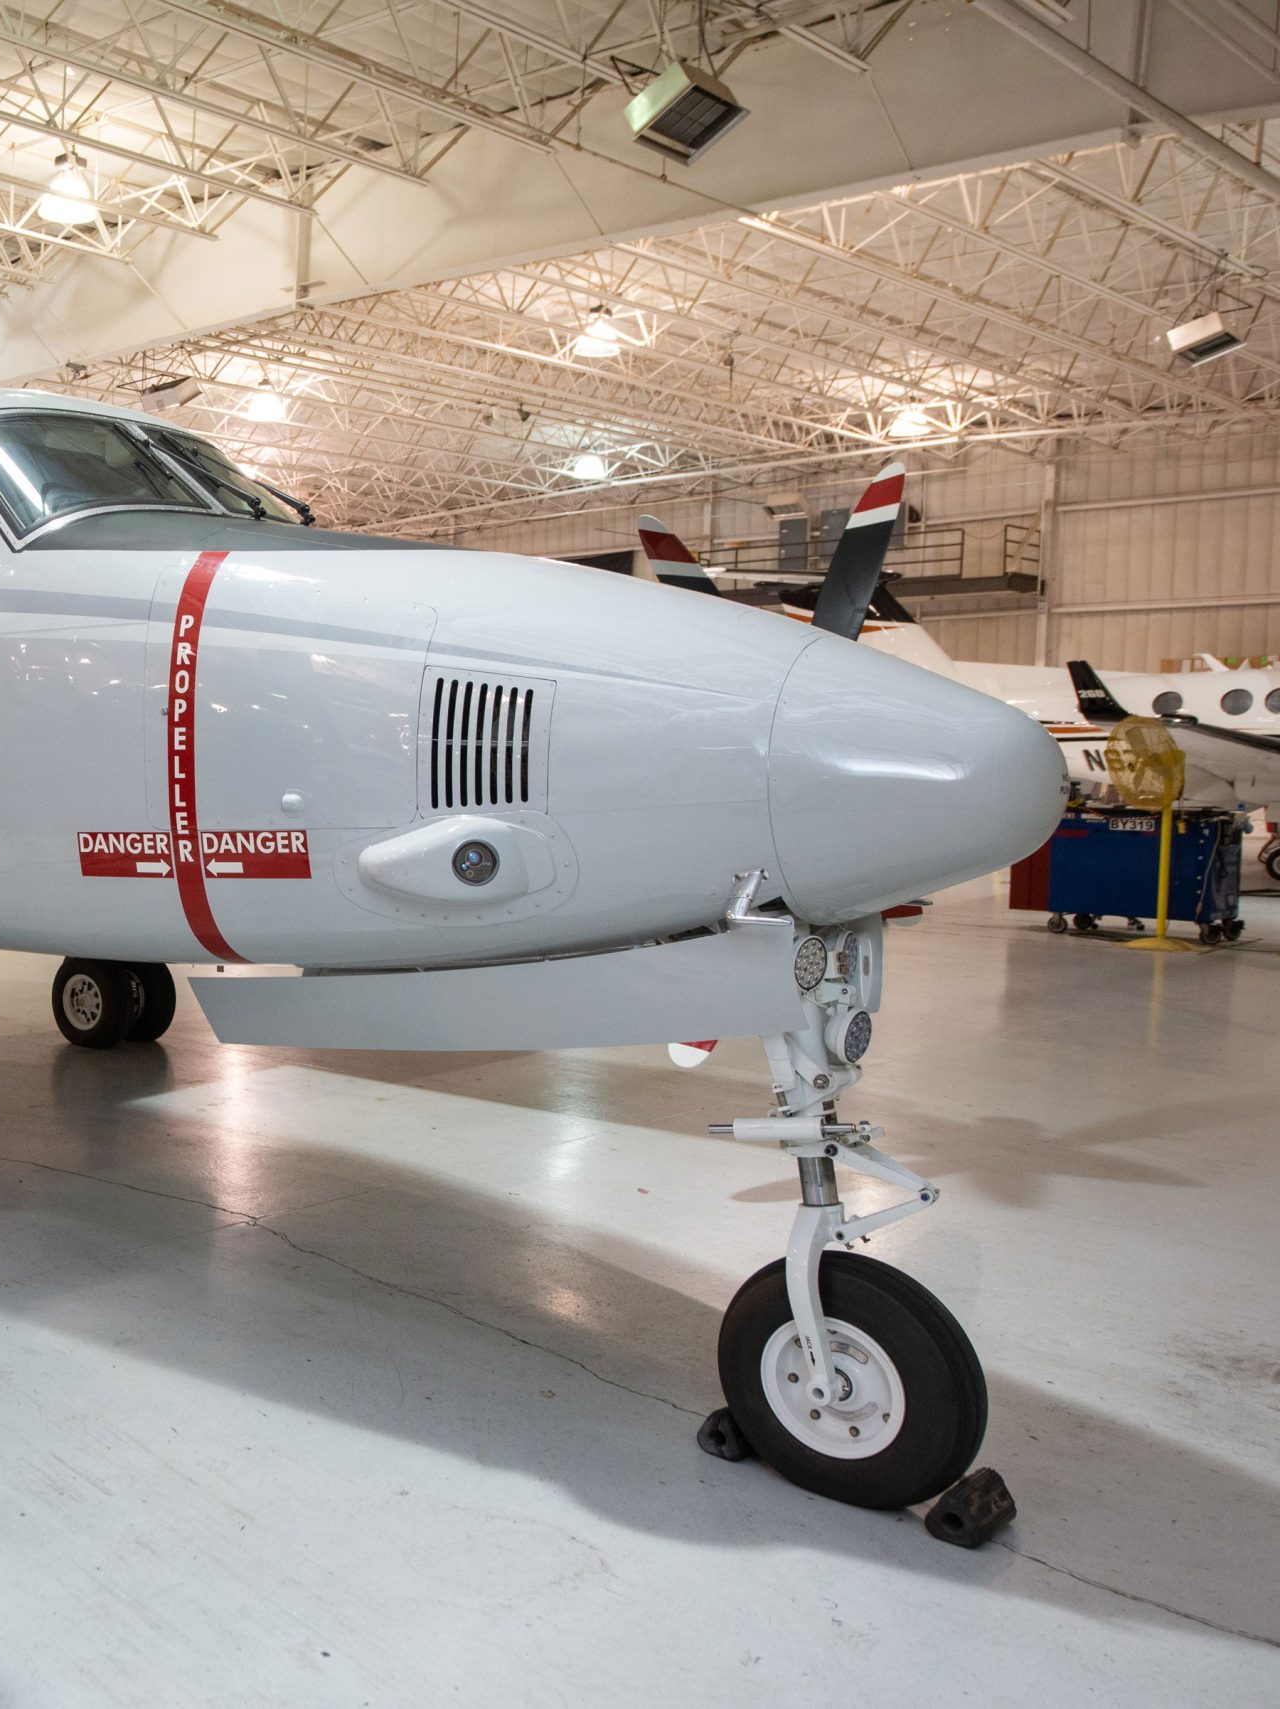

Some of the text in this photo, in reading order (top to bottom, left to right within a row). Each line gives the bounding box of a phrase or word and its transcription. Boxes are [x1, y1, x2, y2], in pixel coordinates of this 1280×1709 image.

[174, 614, 196, 863] PROPELLER
[1111, 820, 1153, 831] BY319
[79, 833, 170, 855] DANGER
[202, 832, 307, 855] DANGER
